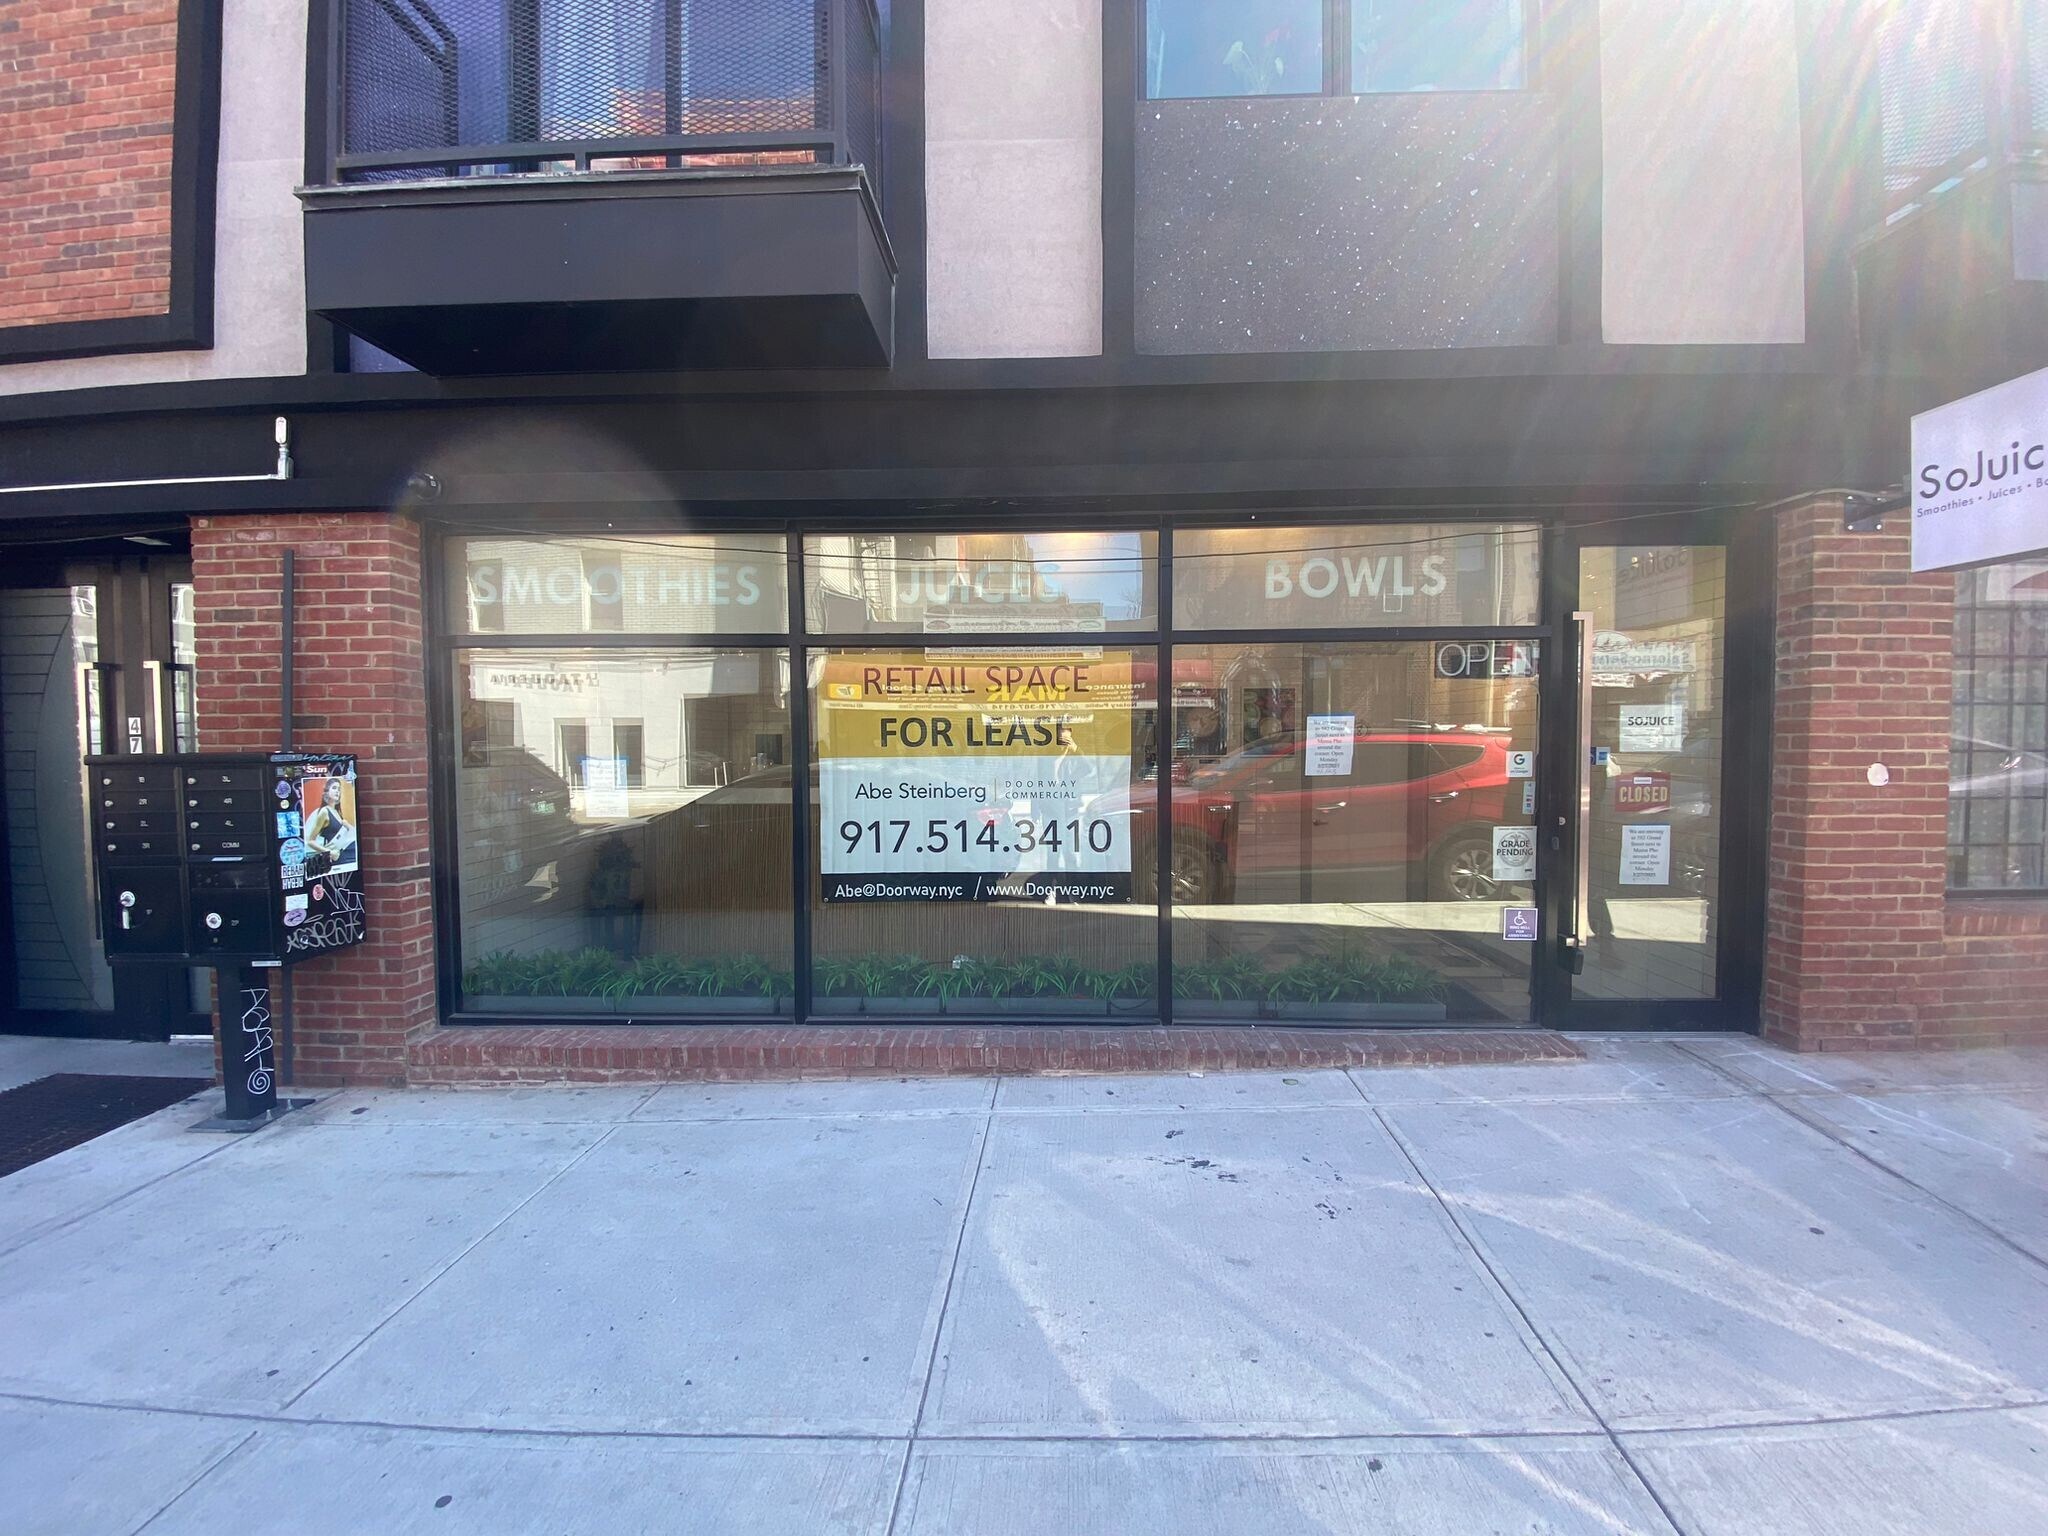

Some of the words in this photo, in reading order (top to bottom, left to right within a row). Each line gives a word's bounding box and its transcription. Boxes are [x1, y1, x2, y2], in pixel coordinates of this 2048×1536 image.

[1917, 497, 1974, 518] Smoothies
[1987, 484, 2023, 501] Juices
[471, 564, 761, 606] SMOOTHIES
[900, 562, 1062, 605] JUICES
[1264, 555, 1447, 600] BOWLS
[1437, 643, 1533, 677] OPEN
[863, 666, 976, 695] RETAIL
[985, 665, 1090, 695] SPACE
[1627, 716, 1675, 726] SOJUICE
[880, 717, 954, 747] FOR
[966, 716, 1067, 747] LEASE
[306, 765, 328, 773] Sun
[854, 782, 893, 800] Abe
[899, 782, 987, 802] Steinberg
[1005, 780, 1077, 789] DOORWAY
[1620, 786, 1668, 802] CLOSED
[1005, 791, 1077, 800] COMMERCIAL
[840, 819, 1112, 854] 917.514.3410
[1501, 840, 1529, 848] GRADE
[1496, 848, 1534, 856] PENDING
[834, 883, 964, 900] Abe@Doorway.nyc
[986, 882, 1115, 898] www.Doorway.nyc
